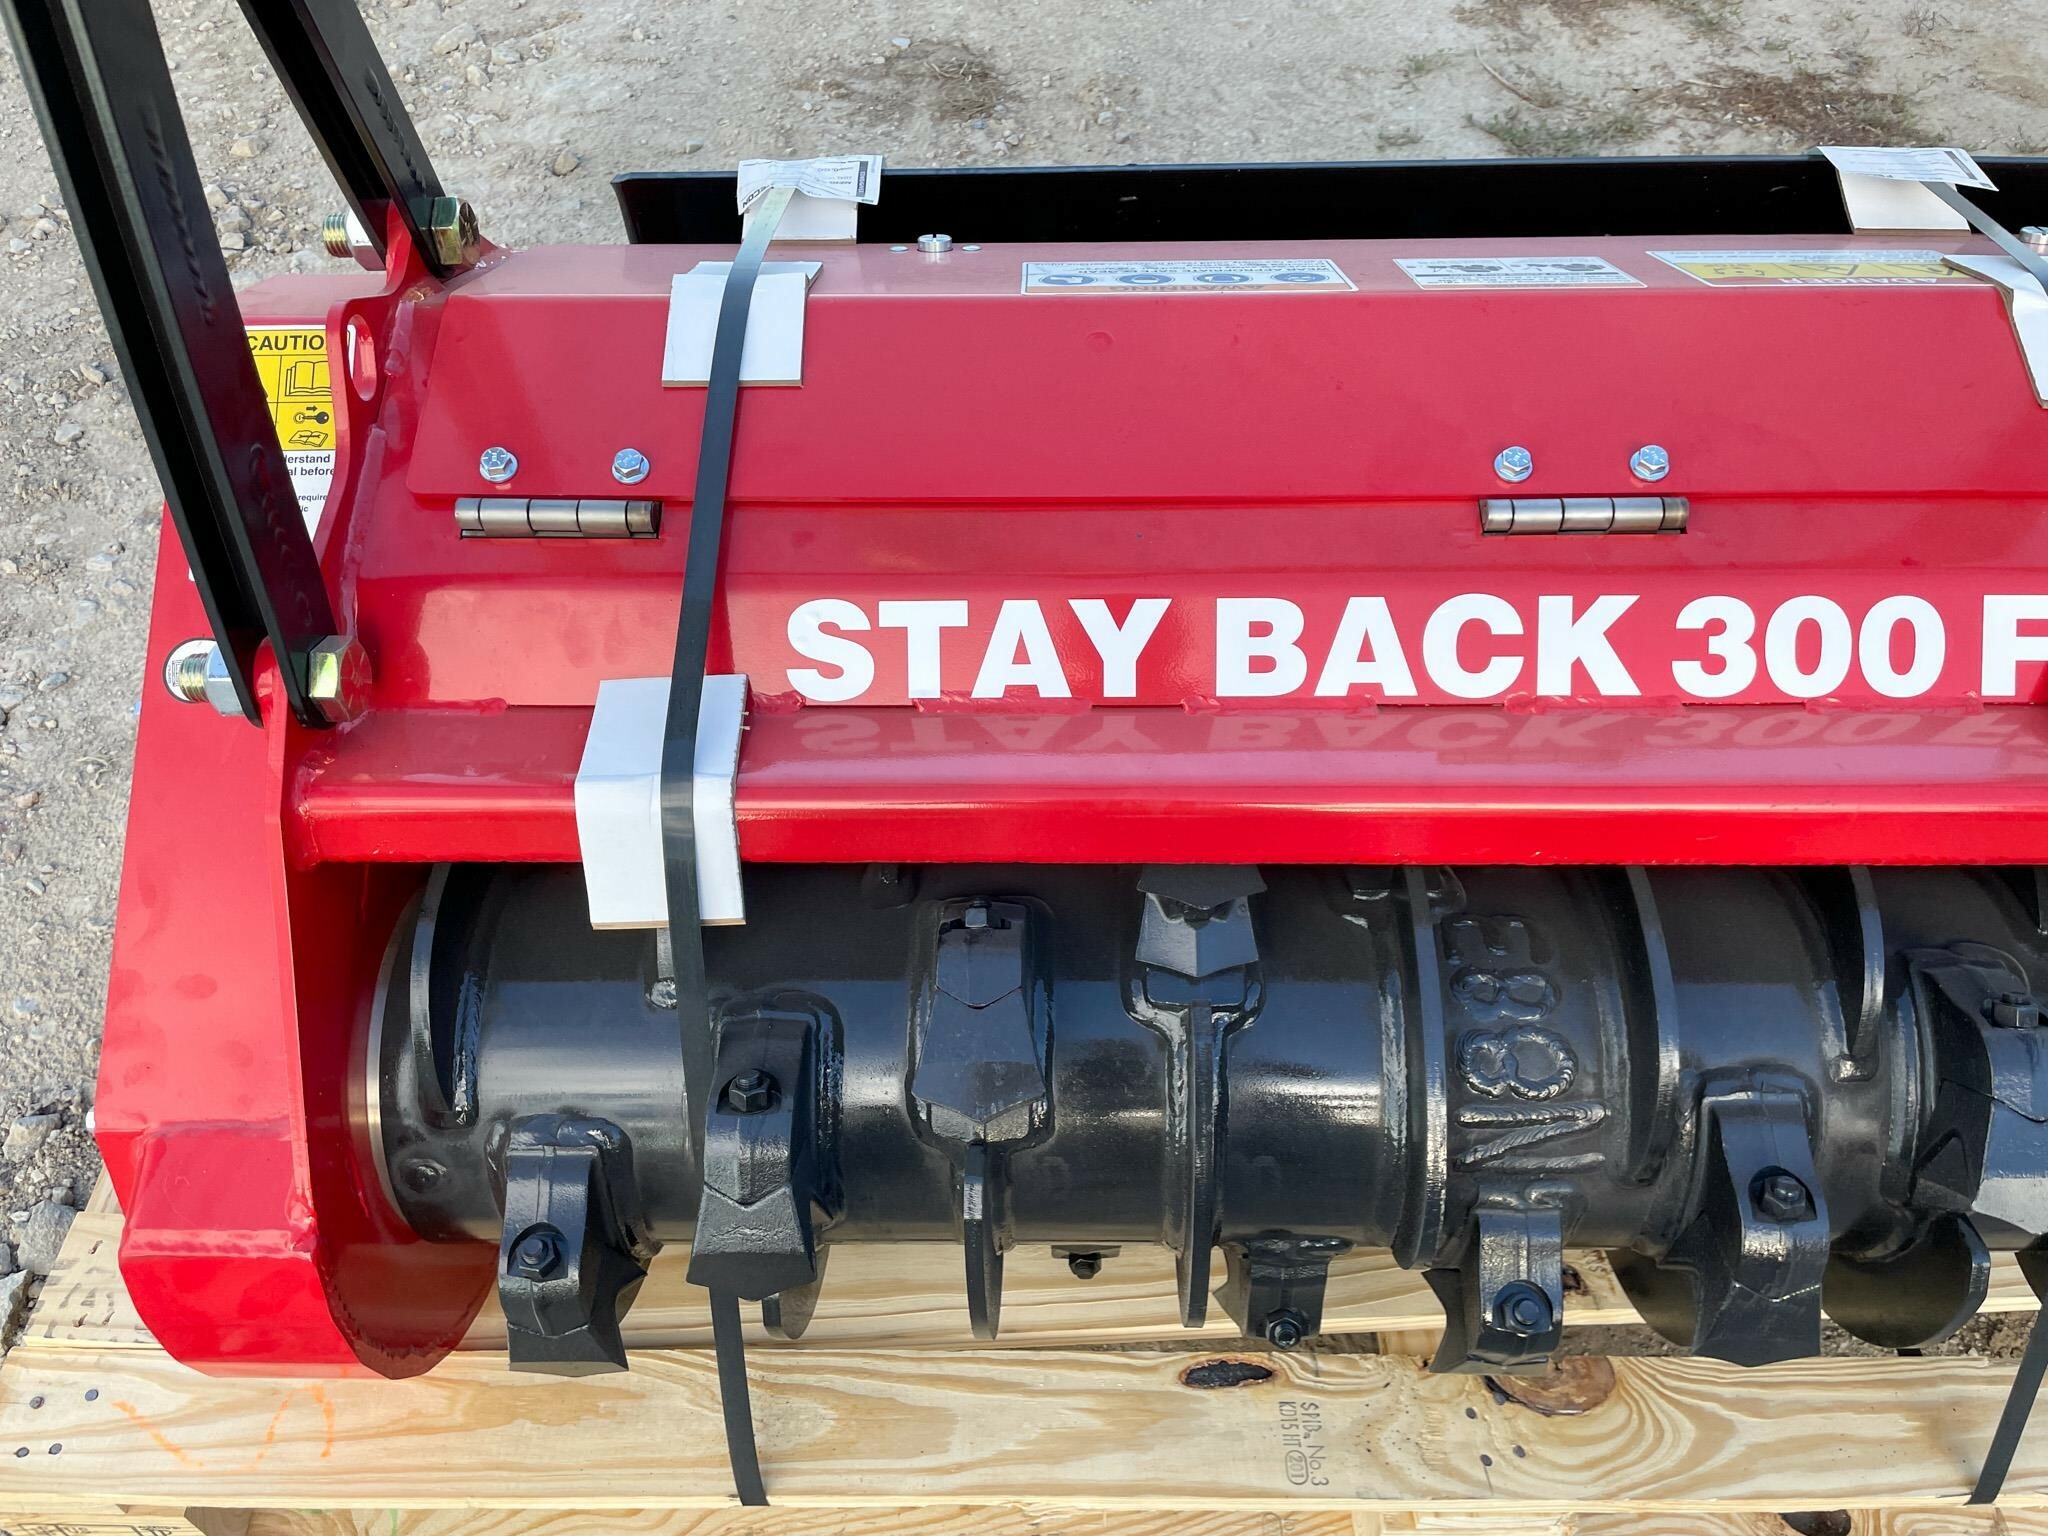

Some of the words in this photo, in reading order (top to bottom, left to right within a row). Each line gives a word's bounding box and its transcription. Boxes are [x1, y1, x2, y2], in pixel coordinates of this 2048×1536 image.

[247, 334, 325, 351] CAUTIO
[785, 598, 1173, 703] STAY
[1215, 593, 1642, 699] BACK
[1671, 594, 1946, 699] 300
